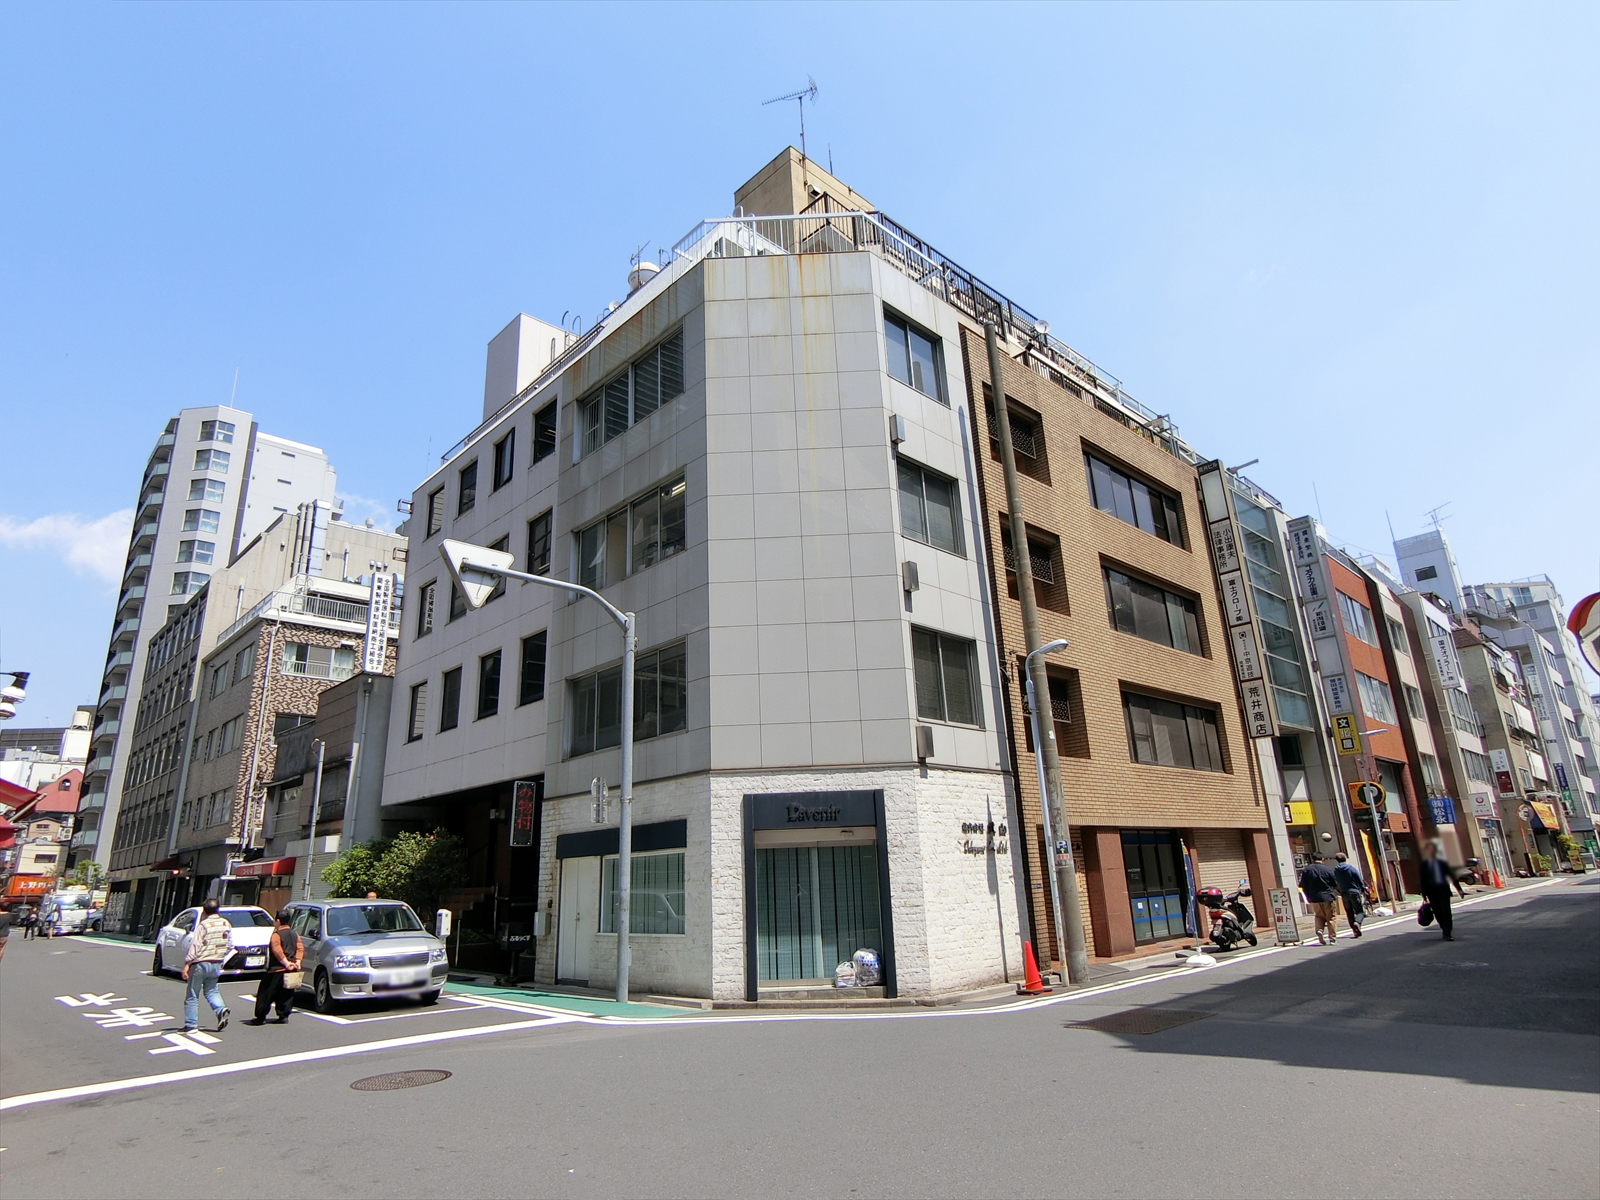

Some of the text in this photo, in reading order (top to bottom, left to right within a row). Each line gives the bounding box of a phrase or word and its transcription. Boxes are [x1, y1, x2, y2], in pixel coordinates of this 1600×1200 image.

[1213, 531, 1228, 569] 法律事務所
[1223, 528, 1236, 559] 小出康夫
[1248, 686, 1268, 736] 荒井商店
[1275, 908, 1283, 922] 印刷
[1280, 891, 1291, 922] スピード
[54, 992, 222, 1056] 止まれ
